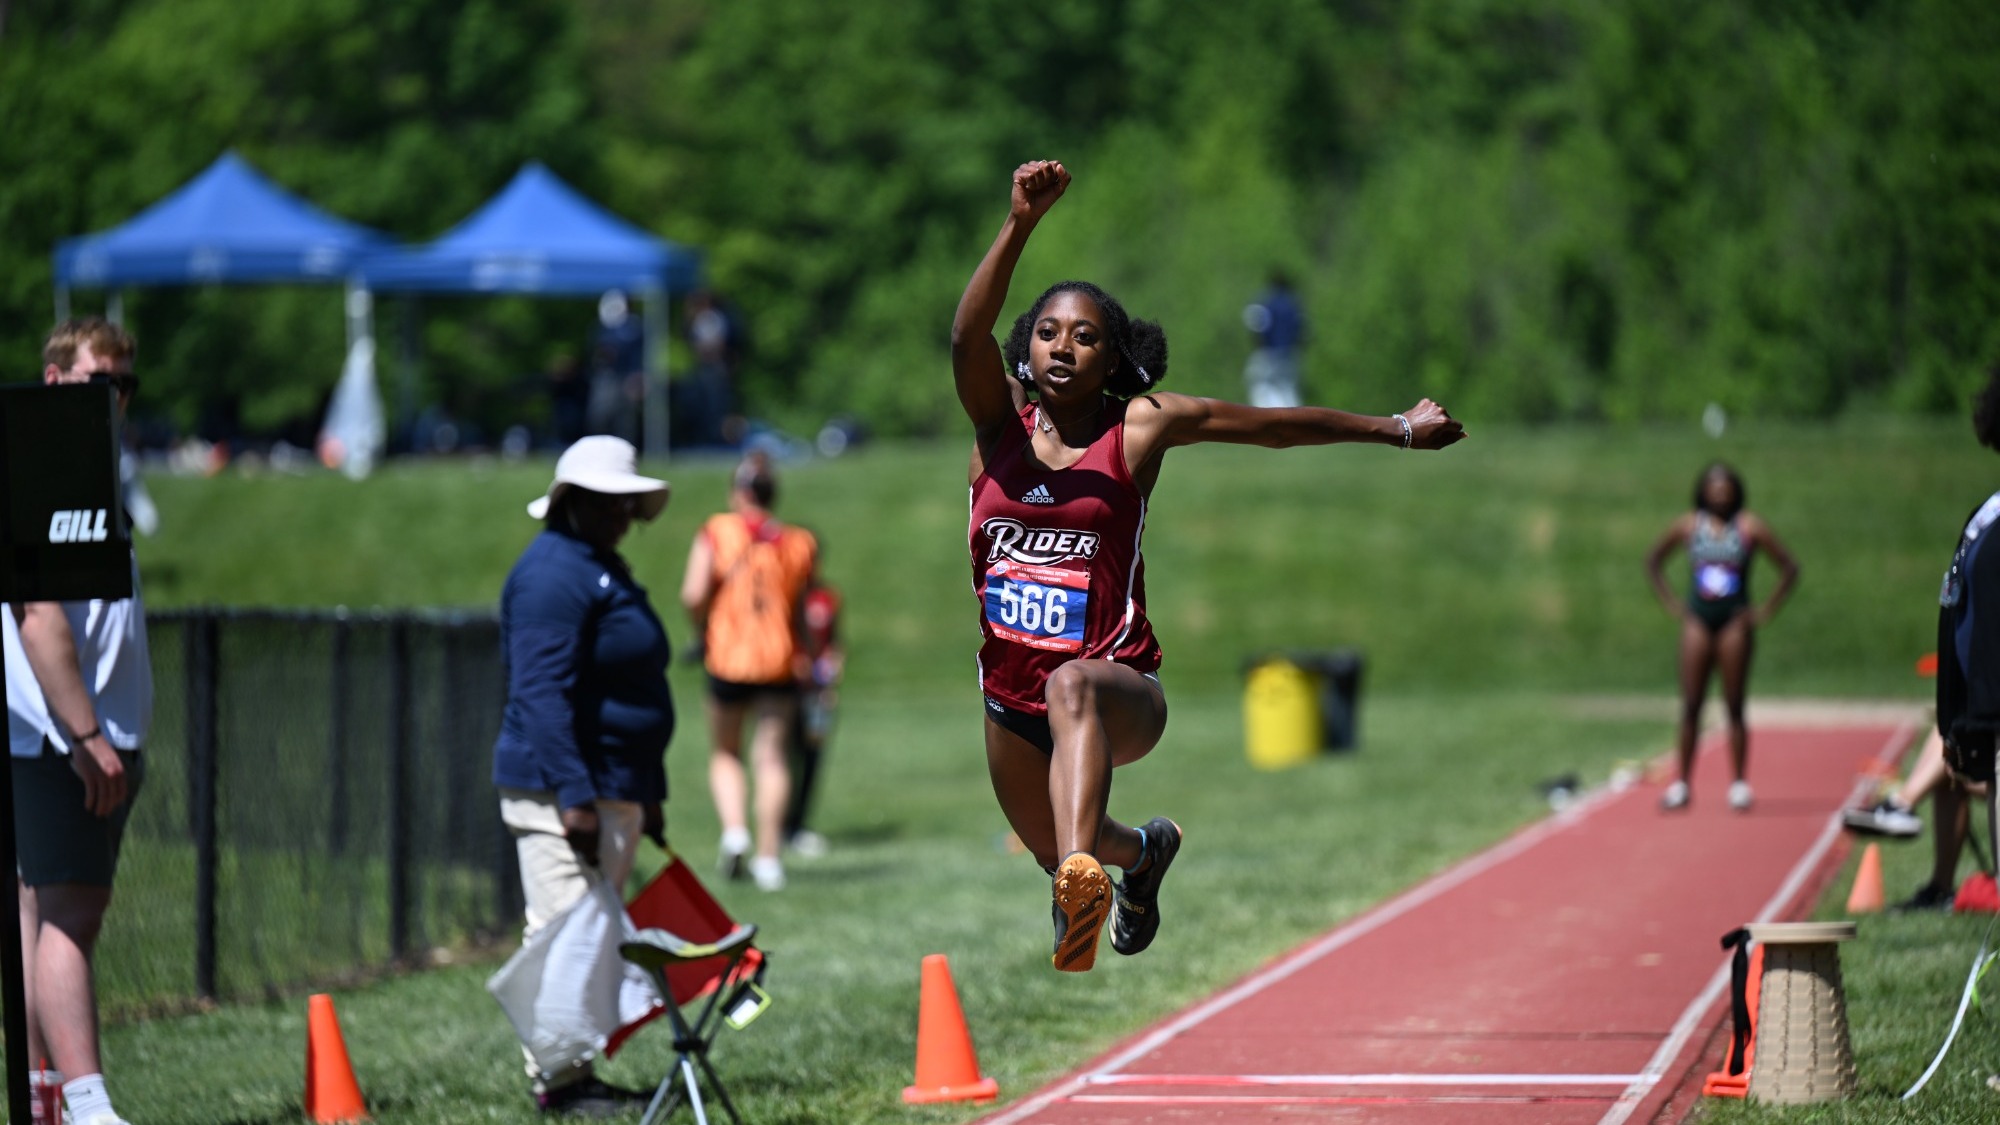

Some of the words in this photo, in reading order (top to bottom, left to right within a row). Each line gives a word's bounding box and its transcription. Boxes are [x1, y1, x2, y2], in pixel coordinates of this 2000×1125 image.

[1022, 494, 1054, 503] adidas
[48, 508, 108, 543] GILL
[983, 519, 1098, 564] RIDER
[1000, 581, 1068, 634] 566
